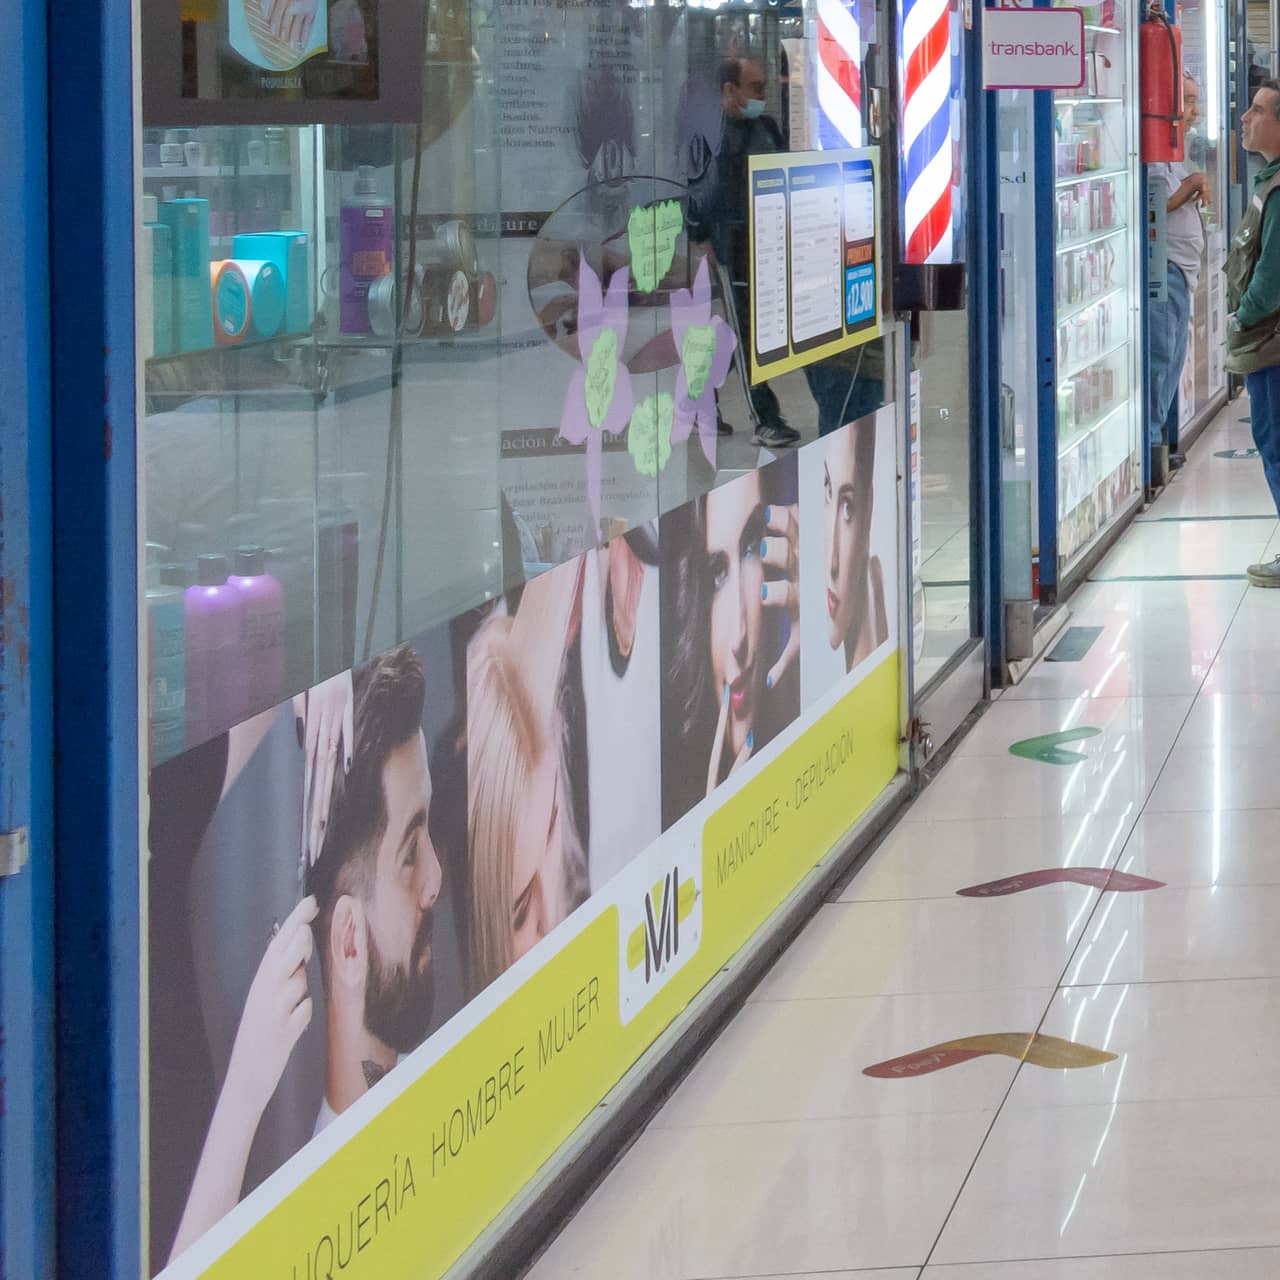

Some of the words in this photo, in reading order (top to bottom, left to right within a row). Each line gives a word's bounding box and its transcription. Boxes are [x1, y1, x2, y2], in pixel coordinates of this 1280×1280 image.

[715, 798, 780, 888] MANICURE
[431, 1046, 526, 1177] HOMBRE
[538, 976, 602, 1073] MUJER
